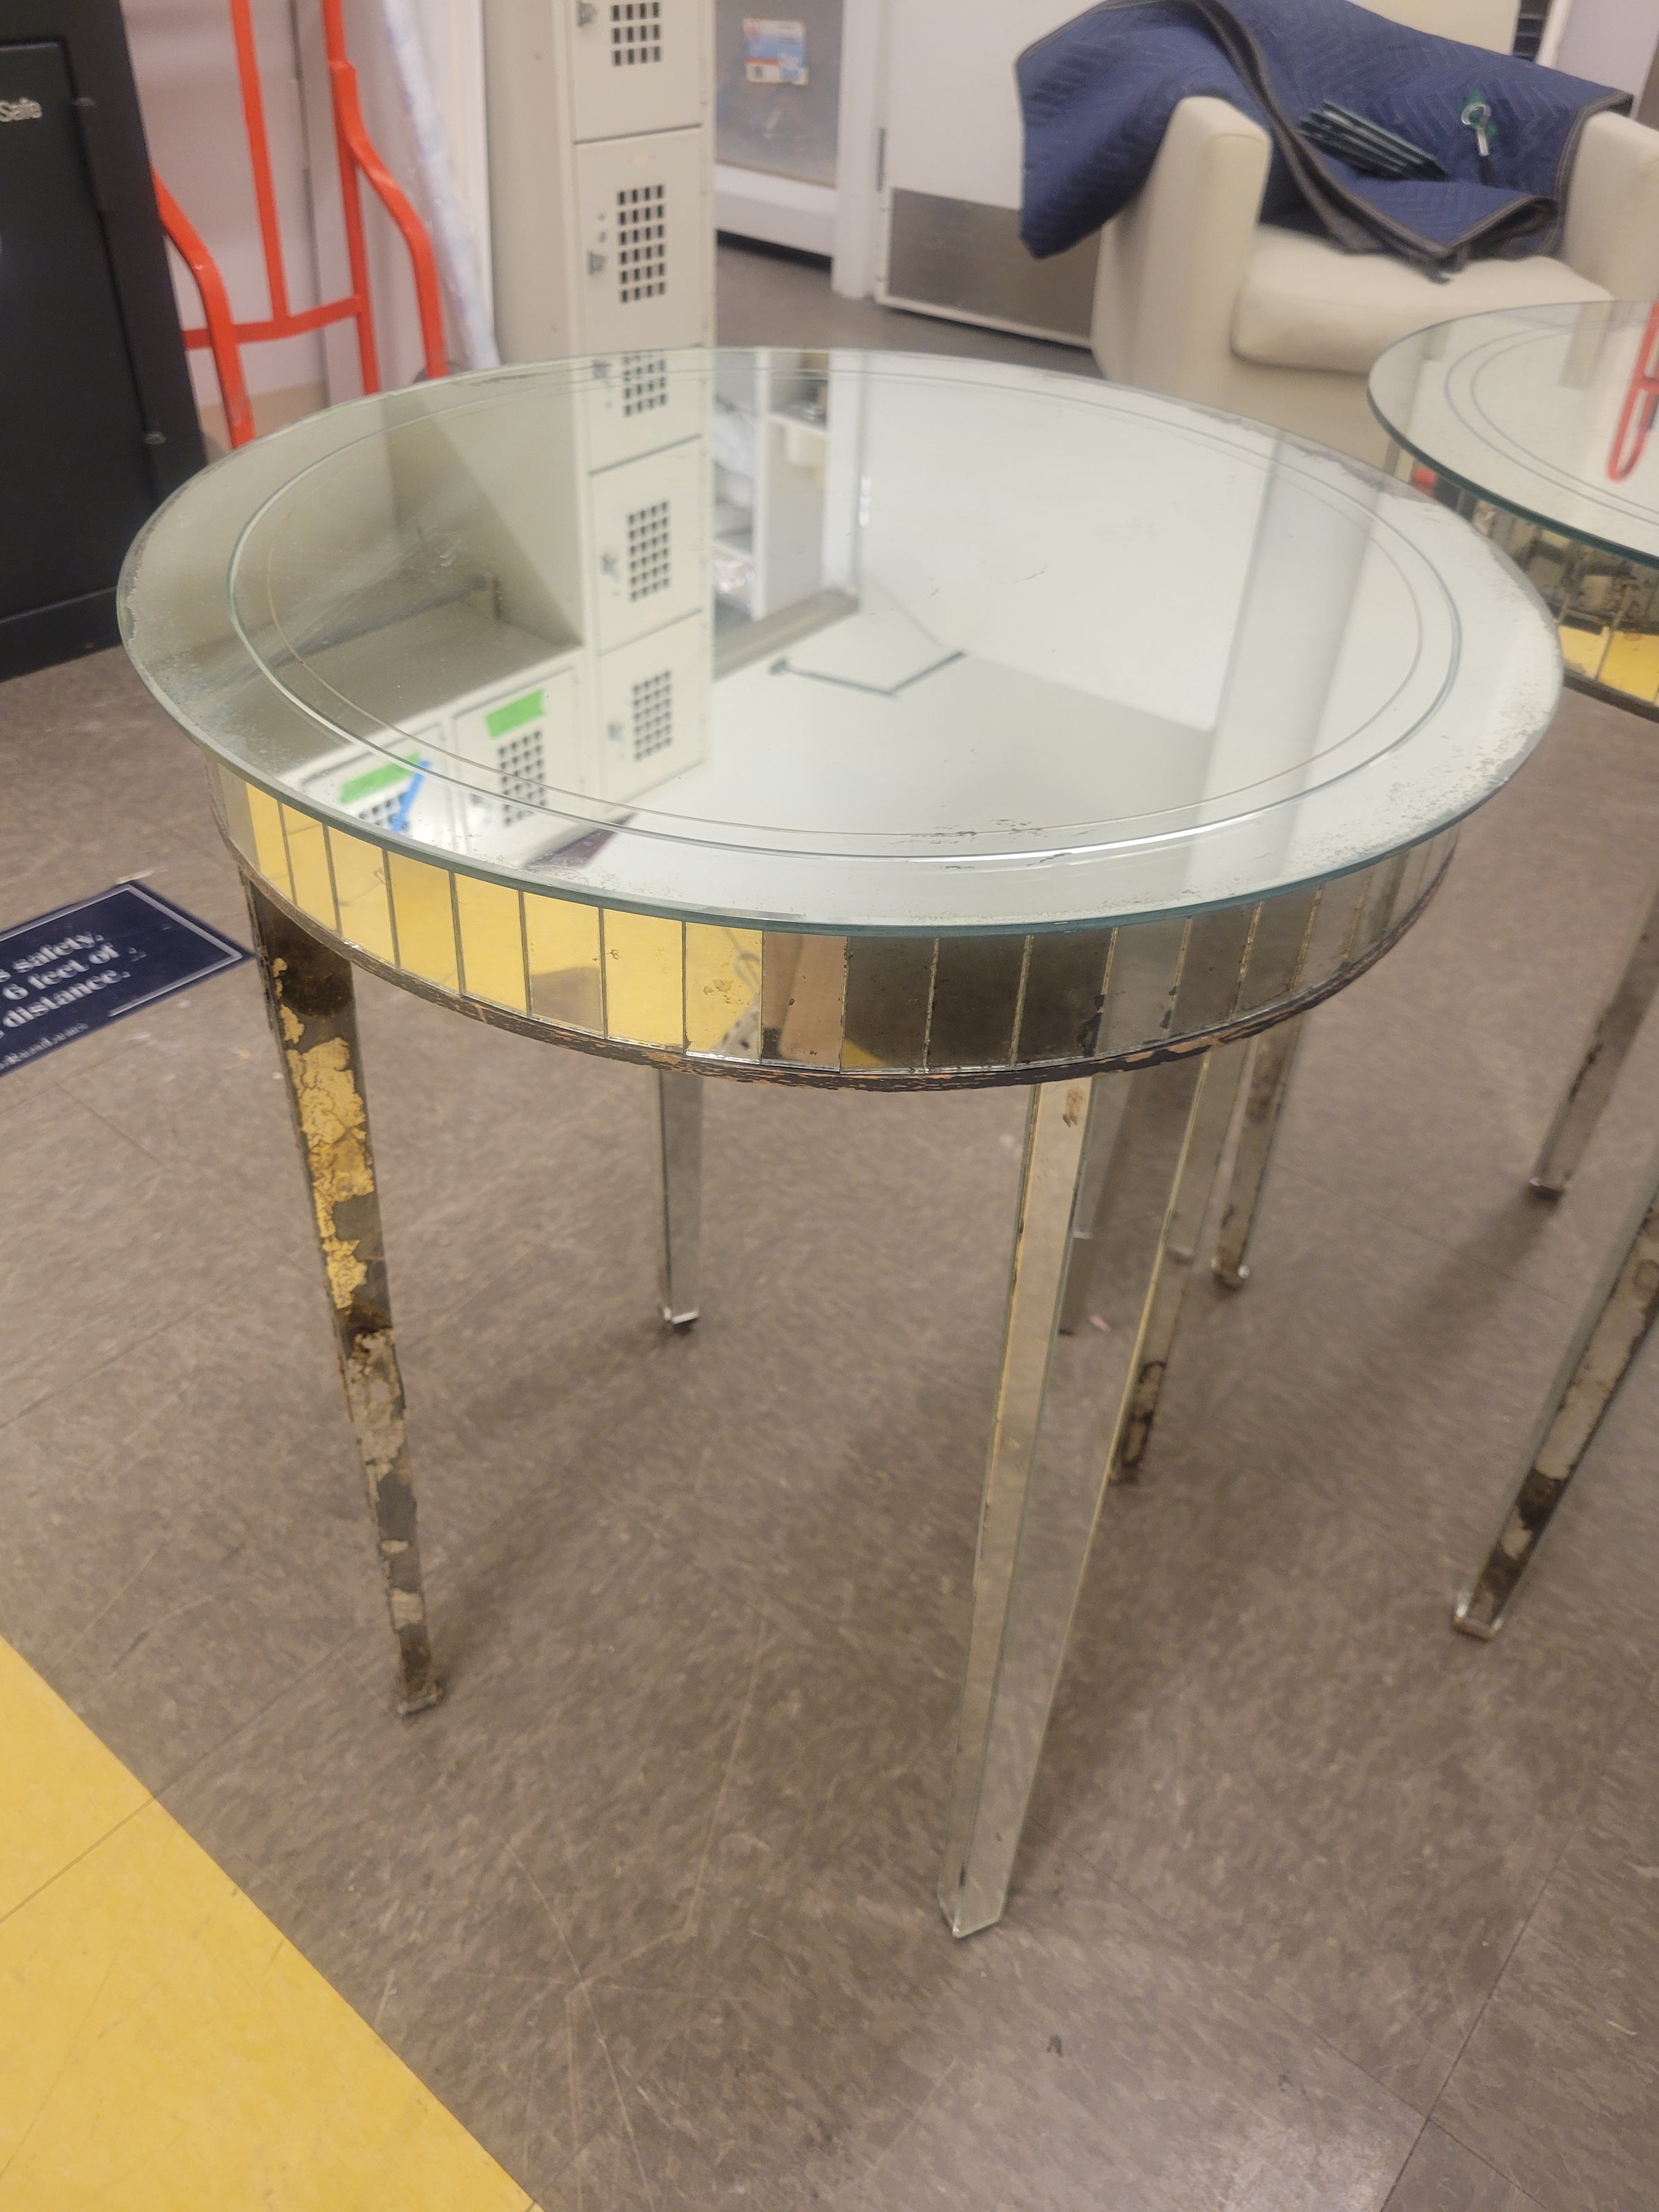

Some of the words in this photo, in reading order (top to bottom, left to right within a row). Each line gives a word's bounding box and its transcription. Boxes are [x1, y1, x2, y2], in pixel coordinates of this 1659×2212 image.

[3, 984, 28, 1000] 6
[28, 959, 89, 989] feet
[88, 942, 120, 964] of
